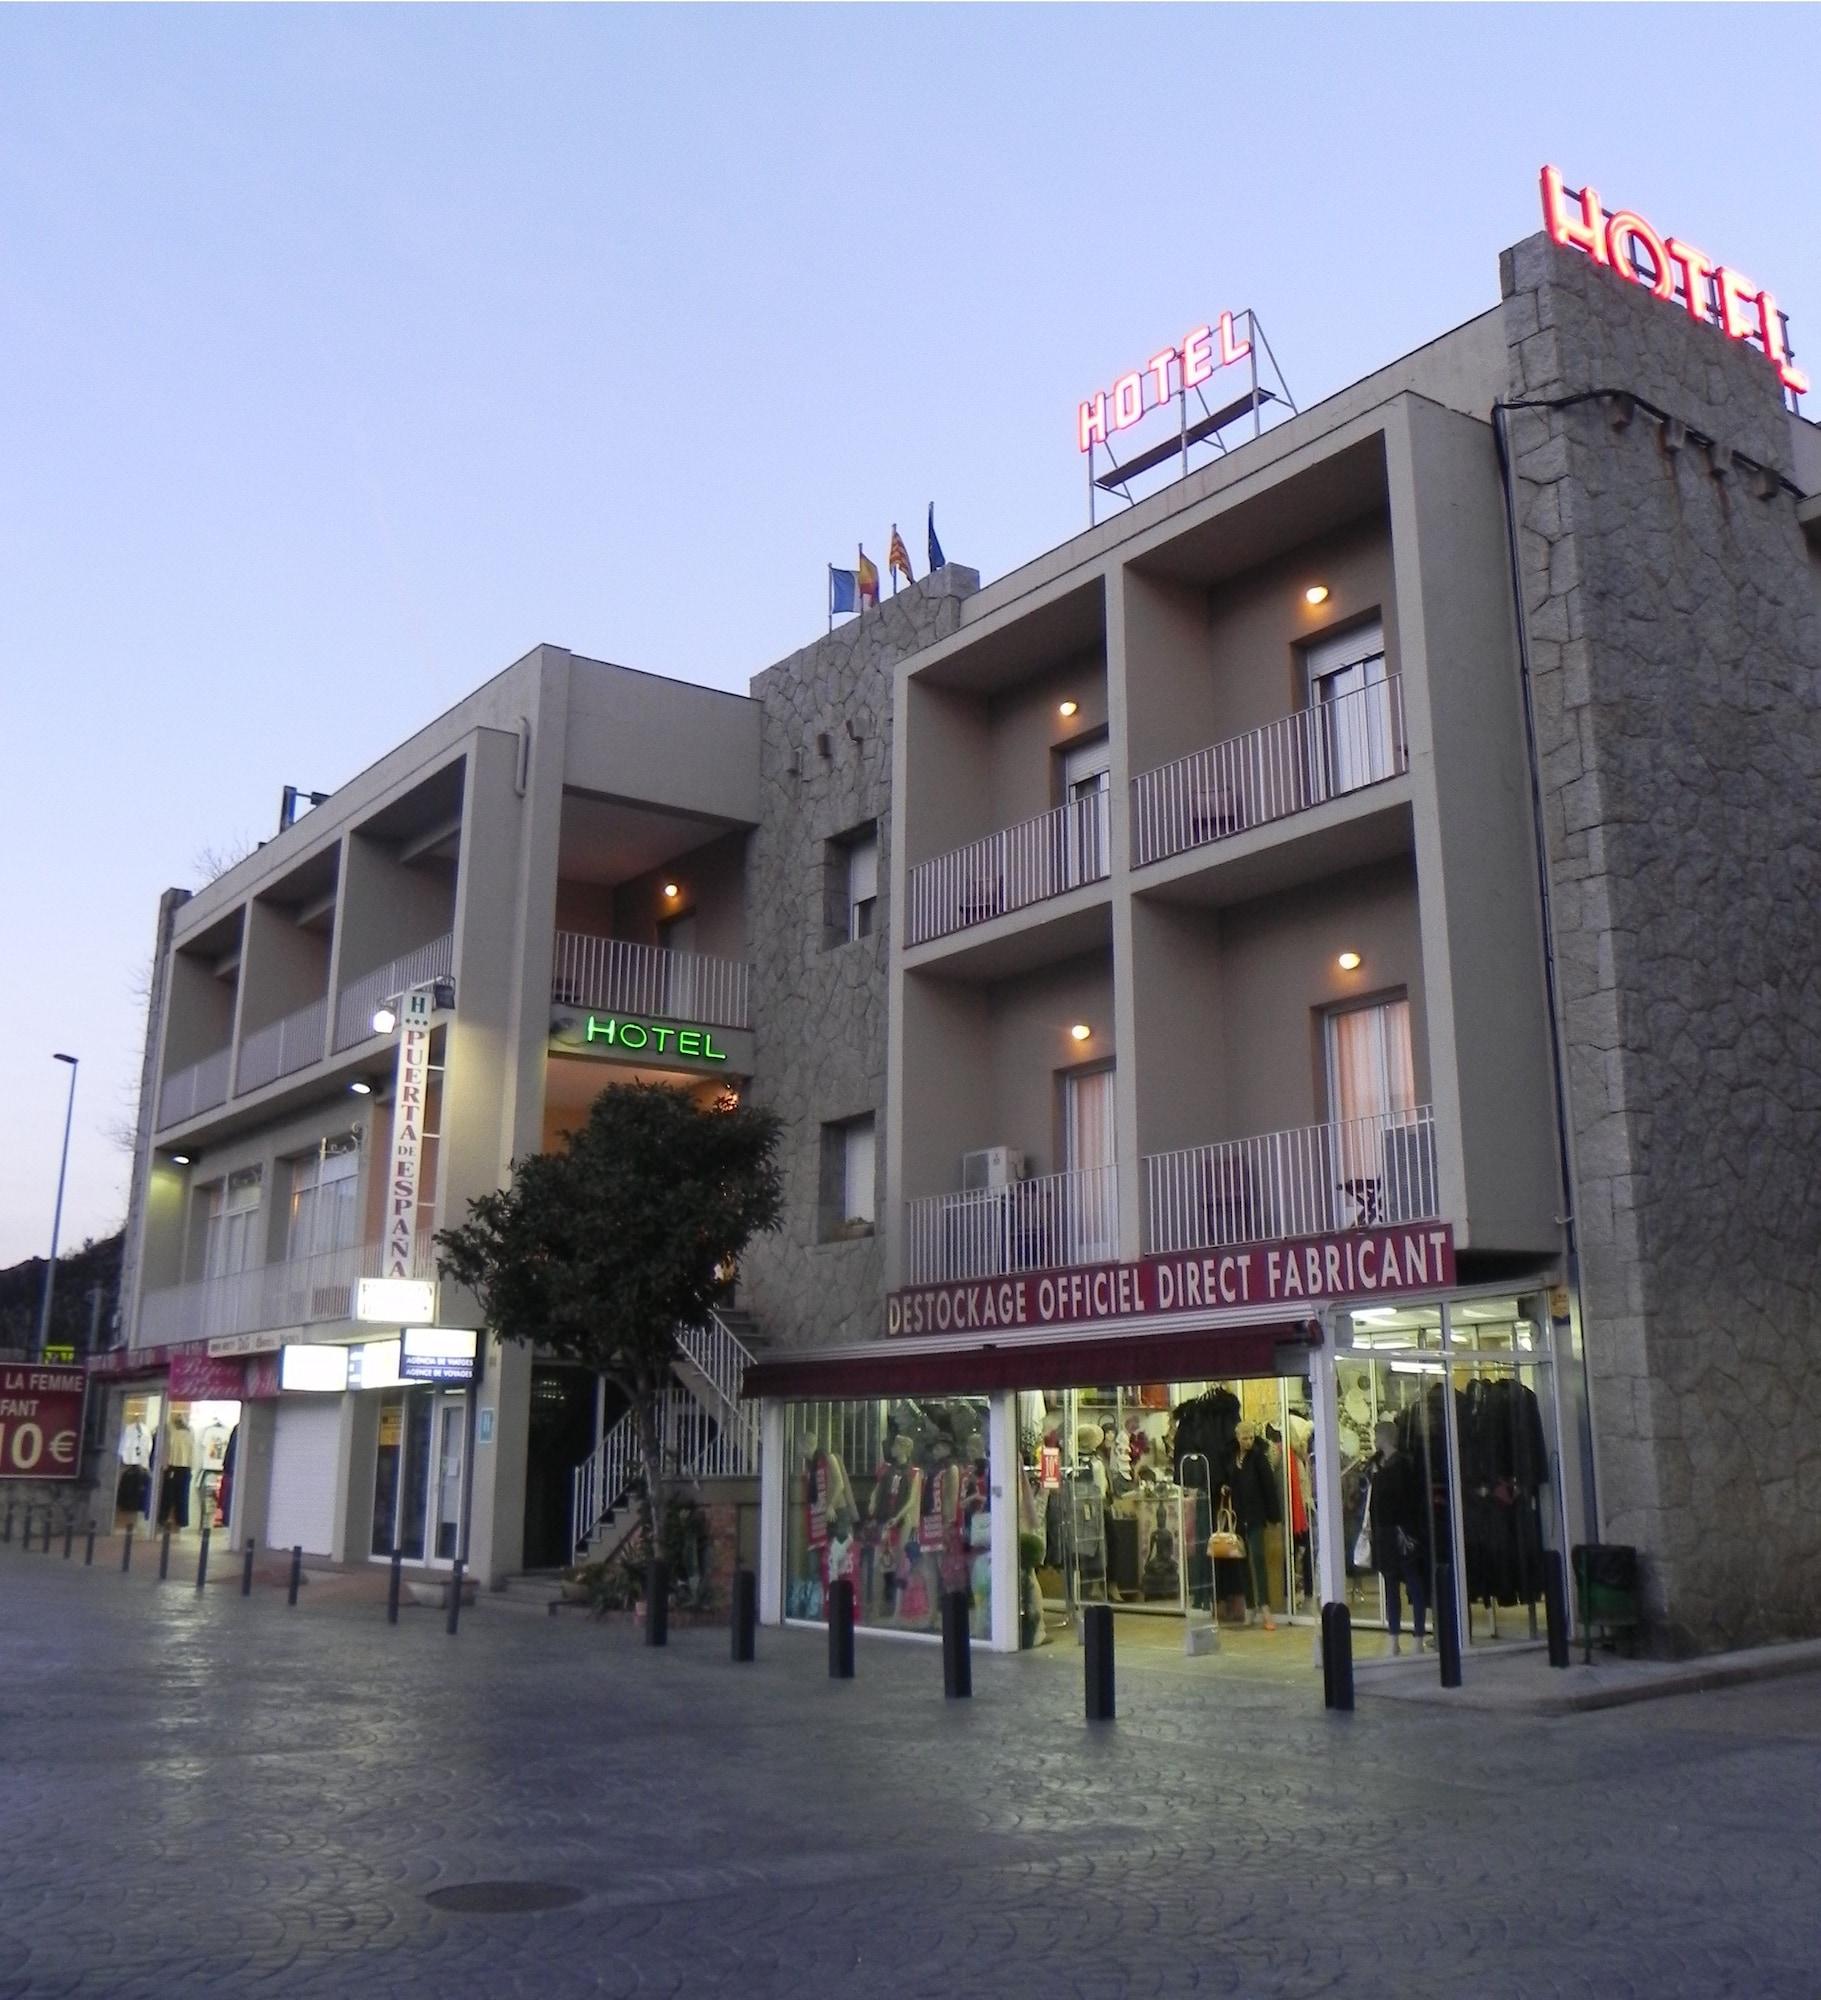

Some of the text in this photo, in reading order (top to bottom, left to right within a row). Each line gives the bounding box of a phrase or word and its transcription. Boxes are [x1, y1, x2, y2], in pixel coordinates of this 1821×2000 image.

[1540, 164, 1810, 394] HOTEL
[1079, 311, 1253, 453] HOTEL
[411, 996, 425, 1014] H
[587, 1015, 727, 1060] HOTEL
[389, 1030, 426, 1278] PUERTA DE ESPAÑA
[888, 1232, 1447, 1336] DESTOCKAGE OFFICIEL DIRECT FABRICANT
[5, 1372, 84, 1393] LA FEMME
[433, 1369, 442, 1377] DE
